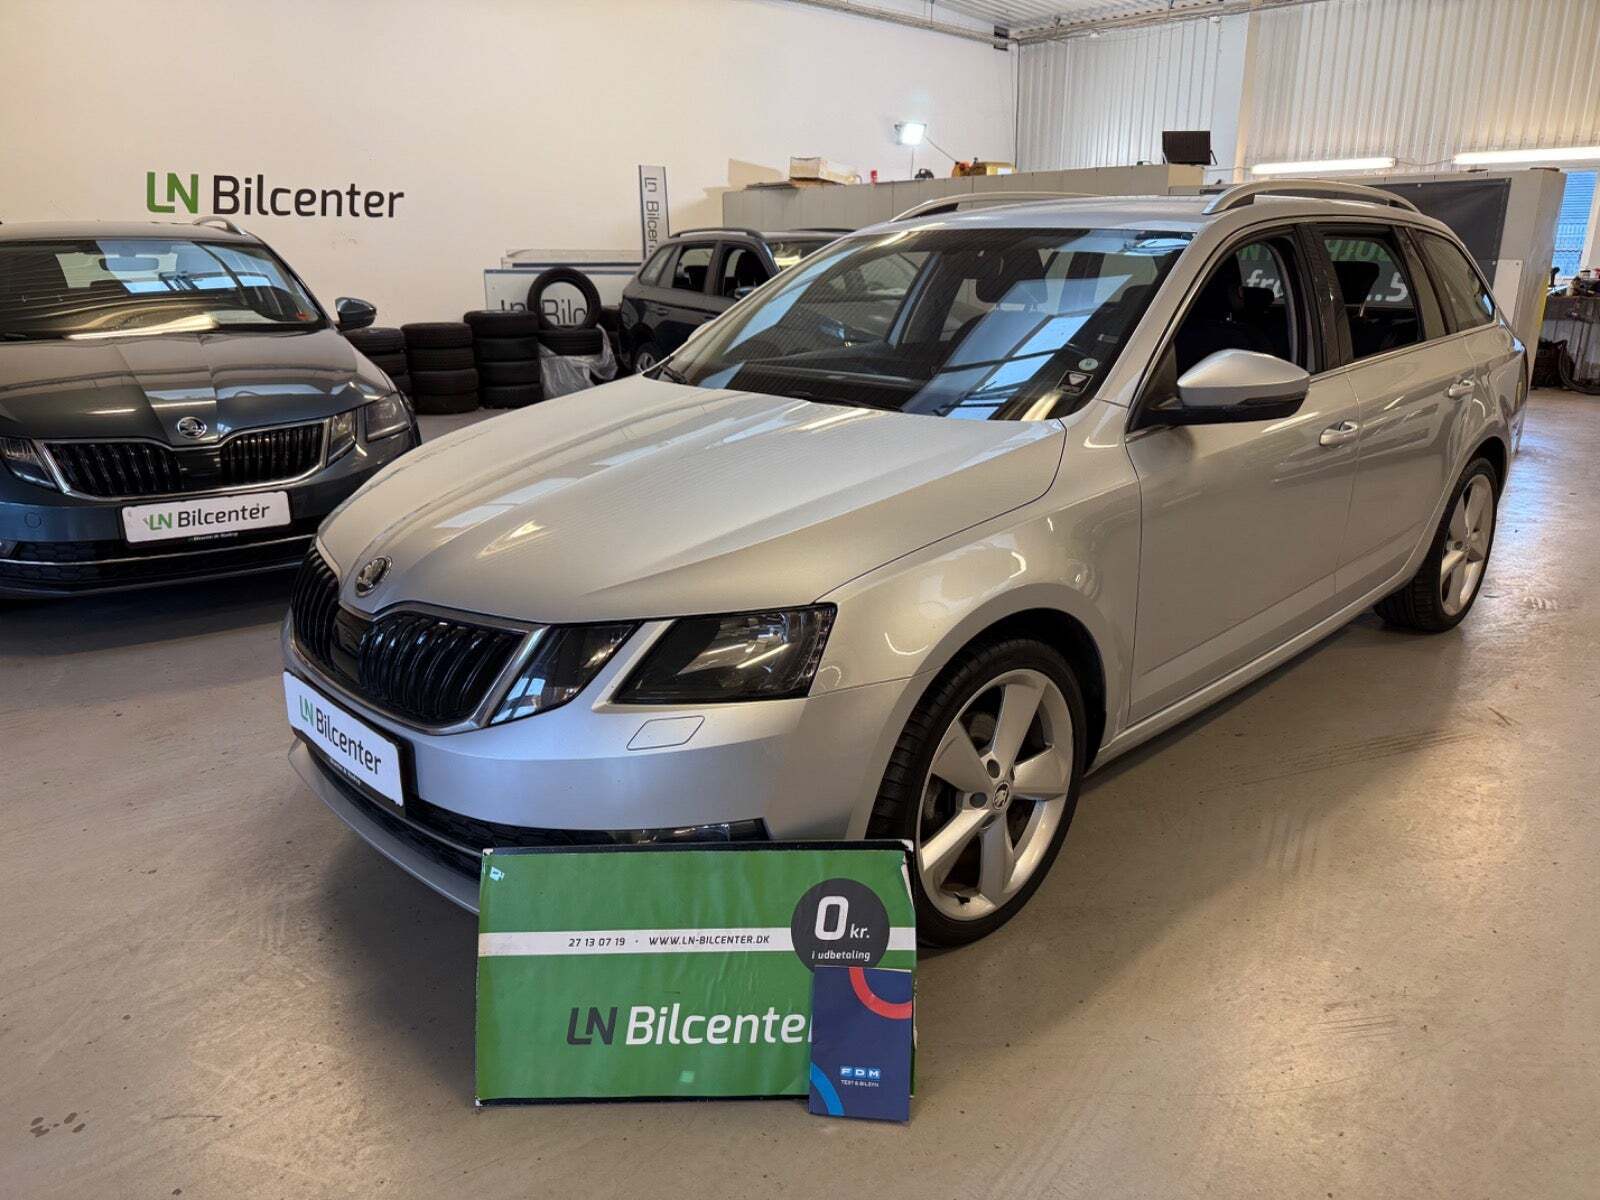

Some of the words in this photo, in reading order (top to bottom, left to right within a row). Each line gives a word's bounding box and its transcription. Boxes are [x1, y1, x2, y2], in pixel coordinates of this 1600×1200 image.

[146, 171, 199, 214] LN
[213, 174, 404, 218] Bilcenter
[149, 512, 173, 531] LN
[177, 505, 270, 528] Bilcenter
[299, 695, 314, 726] LN
[315, 707, 382, 775] Bilcenter
[814, 895, 849, 941] 0
[849, 923, 871, 939] kr.
[567, 938, 581, 947] 27
[585, 938, 595, 947] 13
[598, 937, 611, 947] 07
[614, 937, 626, 946] 19
[649, 935, 770, 946] WWW.LN-BILCENTER.DK
[817, 949, 871, 961] udbetaling
[566, 1006, 618, 1046] LN
[625, 1003, 813, 1046] Bilcente
[840, 1067, 880, 1079] FDM
